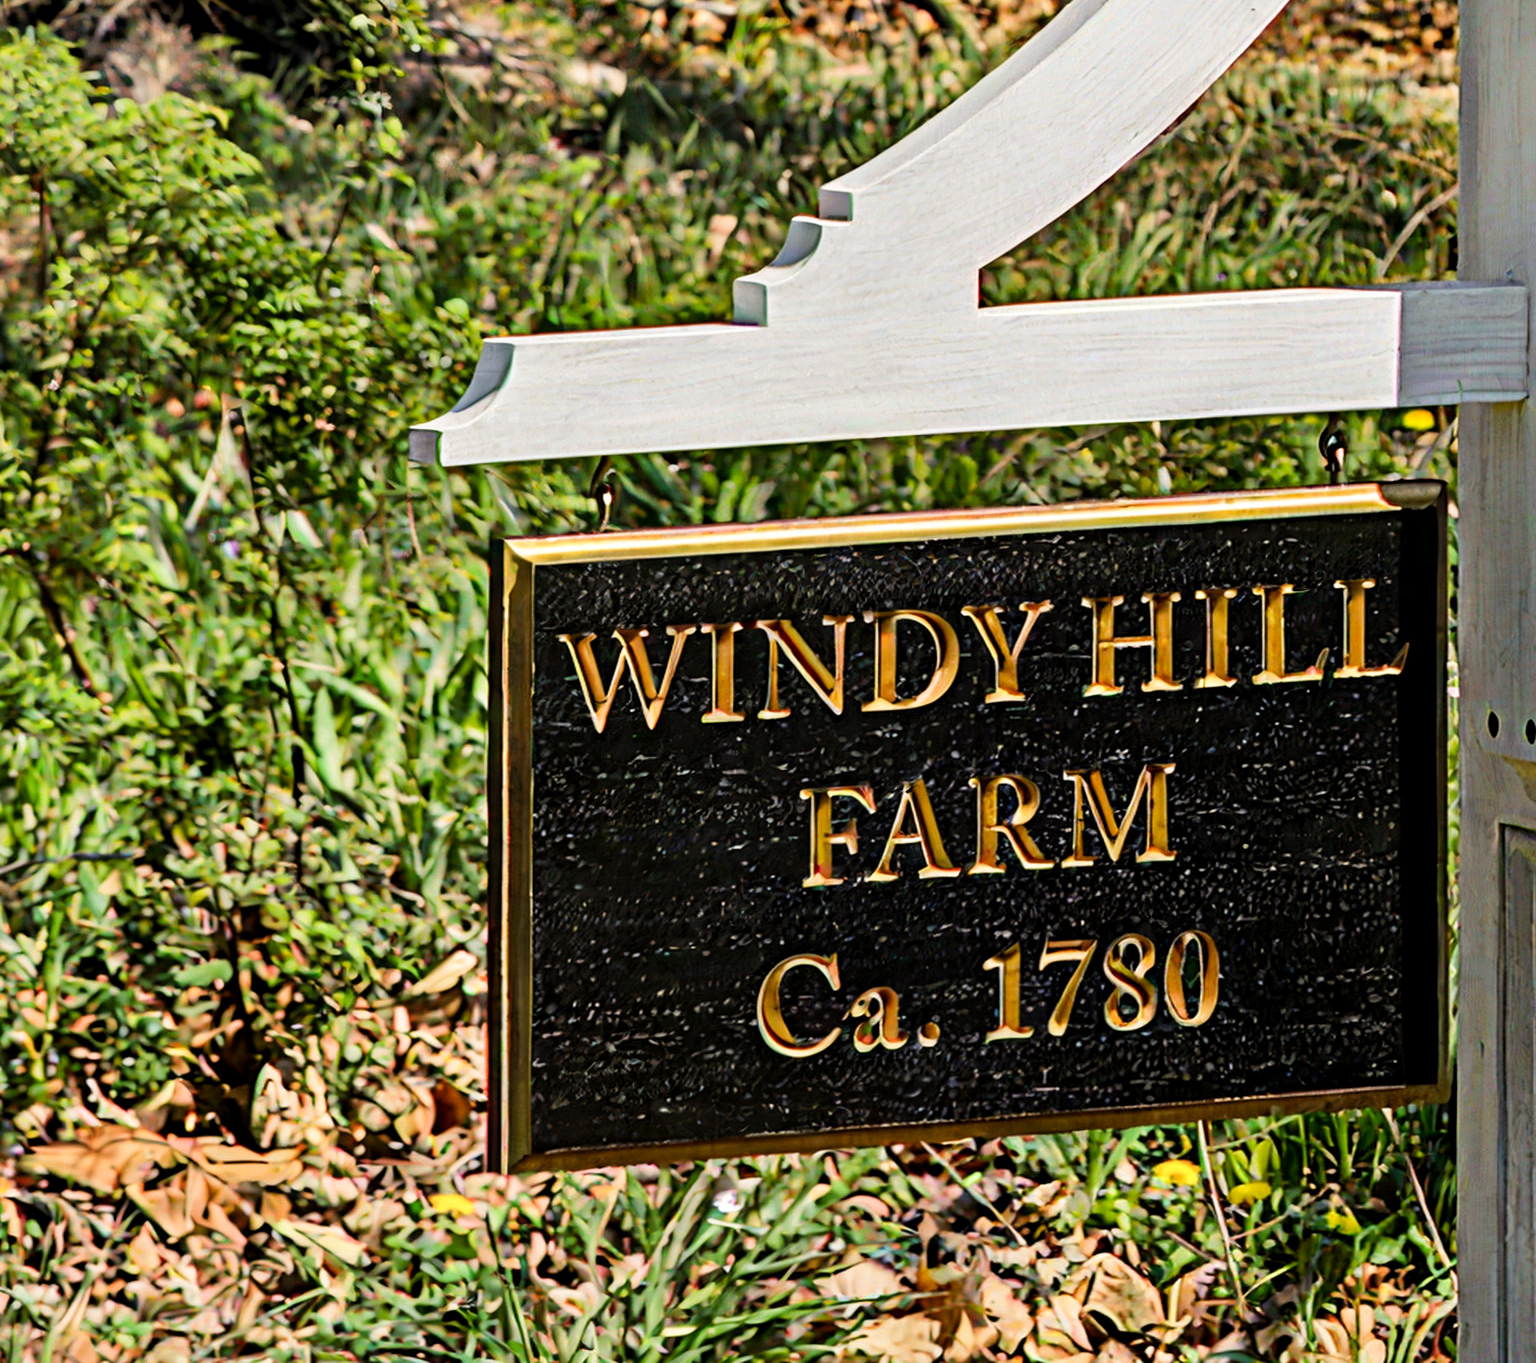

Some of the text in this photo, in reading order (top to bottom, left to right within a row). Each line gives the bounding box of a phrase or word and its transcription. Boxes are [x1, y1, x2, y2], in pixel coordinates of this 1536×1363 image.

[559, 578, 1410, 734] WINDY HILL
[799, 762, 1178, 888] FARM
[756, 929, 1220, 1058] Ca. 1780
